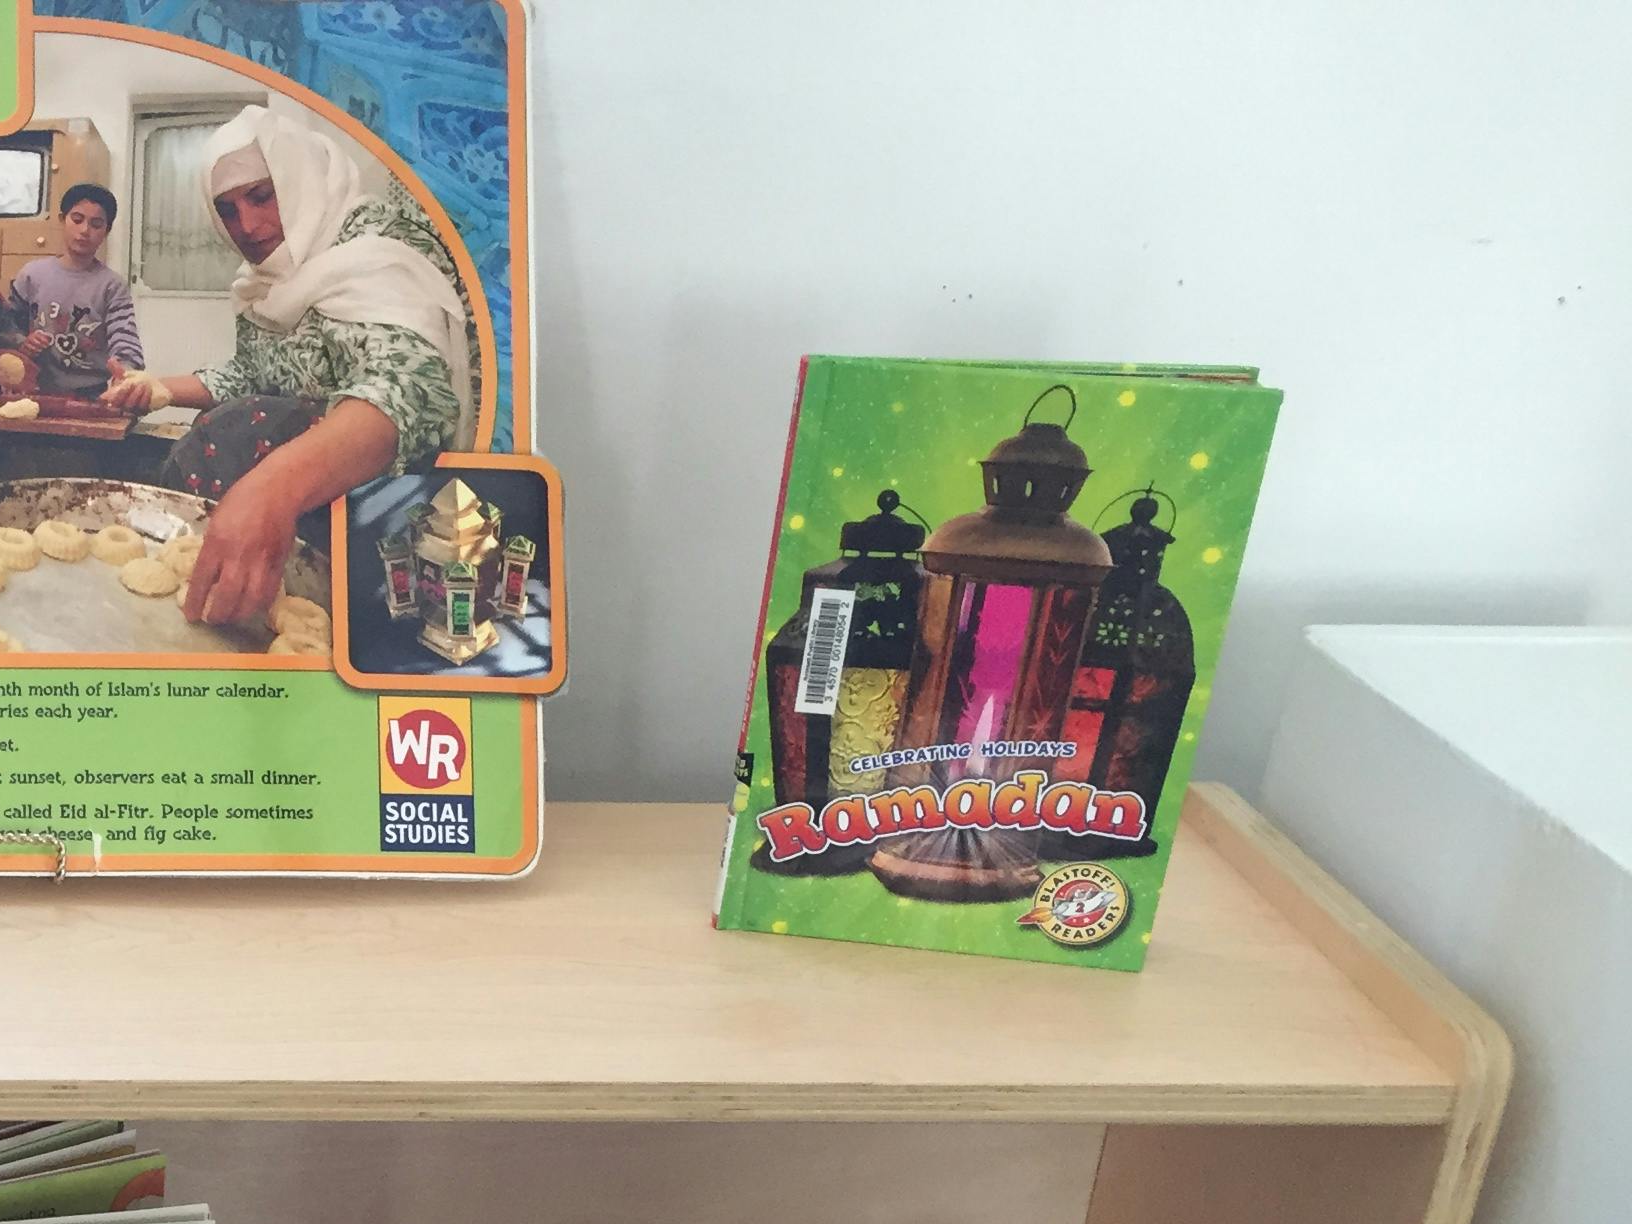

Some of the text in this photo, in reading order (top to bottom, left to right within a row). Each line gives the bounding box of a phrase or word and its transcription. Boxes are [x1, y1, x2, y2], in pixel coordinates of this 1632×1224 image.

[29, 682, 79, 696] month
[86, 682, 102, 696] of
[108, 682, 160, 696] Islam's
[167, 682, 210, 697] lunar
[216, 683, 288, 698] calendar.
[35, 704, 72, 718] each
[78, 707, 117, 722] year.
[850, 742, 1076, 772] CELEBRATING HOLIDAYS
[9, 772, 66, 786] sunset,
[74, 770, 154, 784] observers
[162, 772, 187, 784] eat
[194, 773, 204, 784] a
[211, 770, 254, 784] small
[261, 770, 320, 785] dinner.
[4, 804, 52, 819] called
[60, 804, 86, 819] Eid
[94, 804, 154, 819] al-Fitr.
[161, 804, 218, 822] People
[226, 805, 313, 819] sometimes
[385, 802, 468, 822] SOCIAL
[757, 771, 1146, 861] Ramadan
[106, 826, 136, 840] and
[144, 825, 166, 844] fig
[173, 826, 216, 840] cake.
[385, 824, 469, 845] STUDIES
[1040, 868, 1116, 902] BLASTOFF!
[1075, 902, 1086, 913] 2
[1050, 905, 1120, 939] READERS
